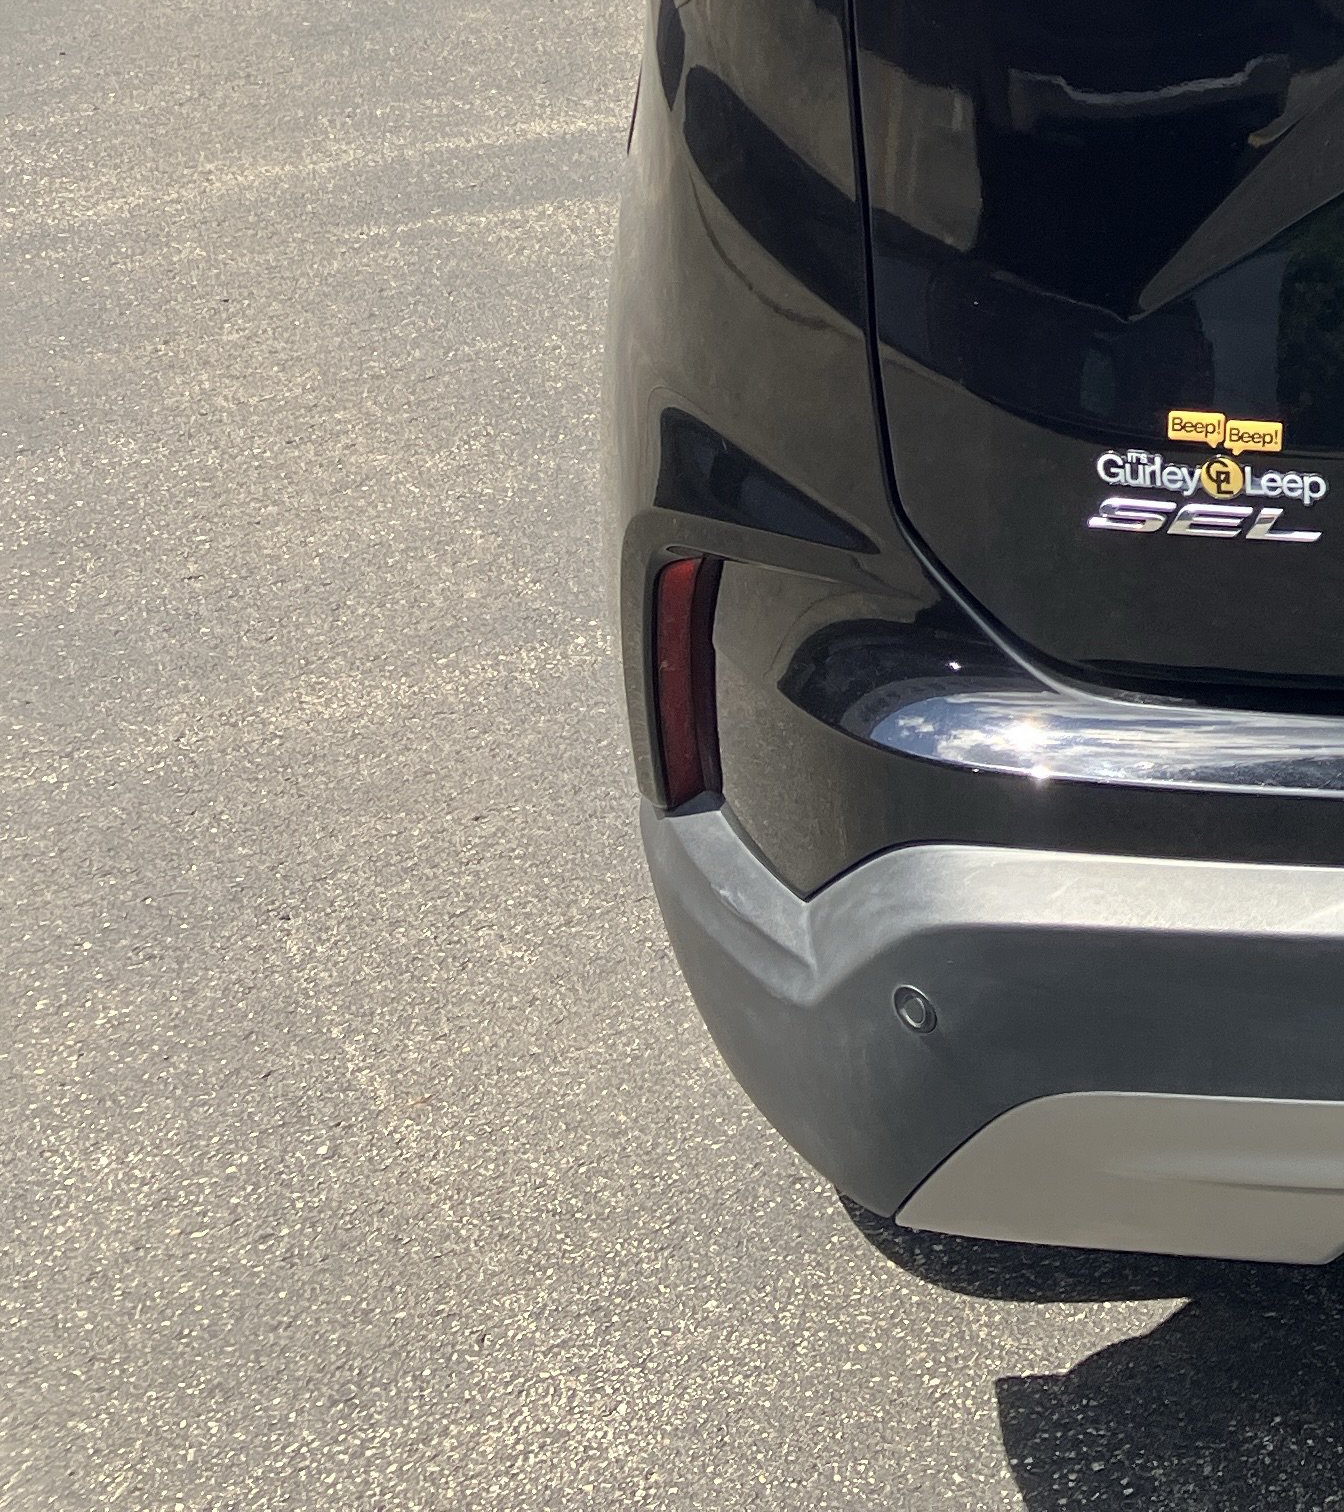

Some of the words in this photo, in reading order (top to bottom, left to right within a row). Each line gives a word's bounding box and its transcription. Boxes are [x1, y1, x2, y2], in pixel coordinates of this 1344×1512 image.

[1171, 417, 1222, 437] Beep!
[1229, 428, 1279, 447] Beep!
[1097, 453, 1201, 496] Gurley
[1244, 466, 1327, 506] Leep
[1087, 497, 1323, 543] SEL
